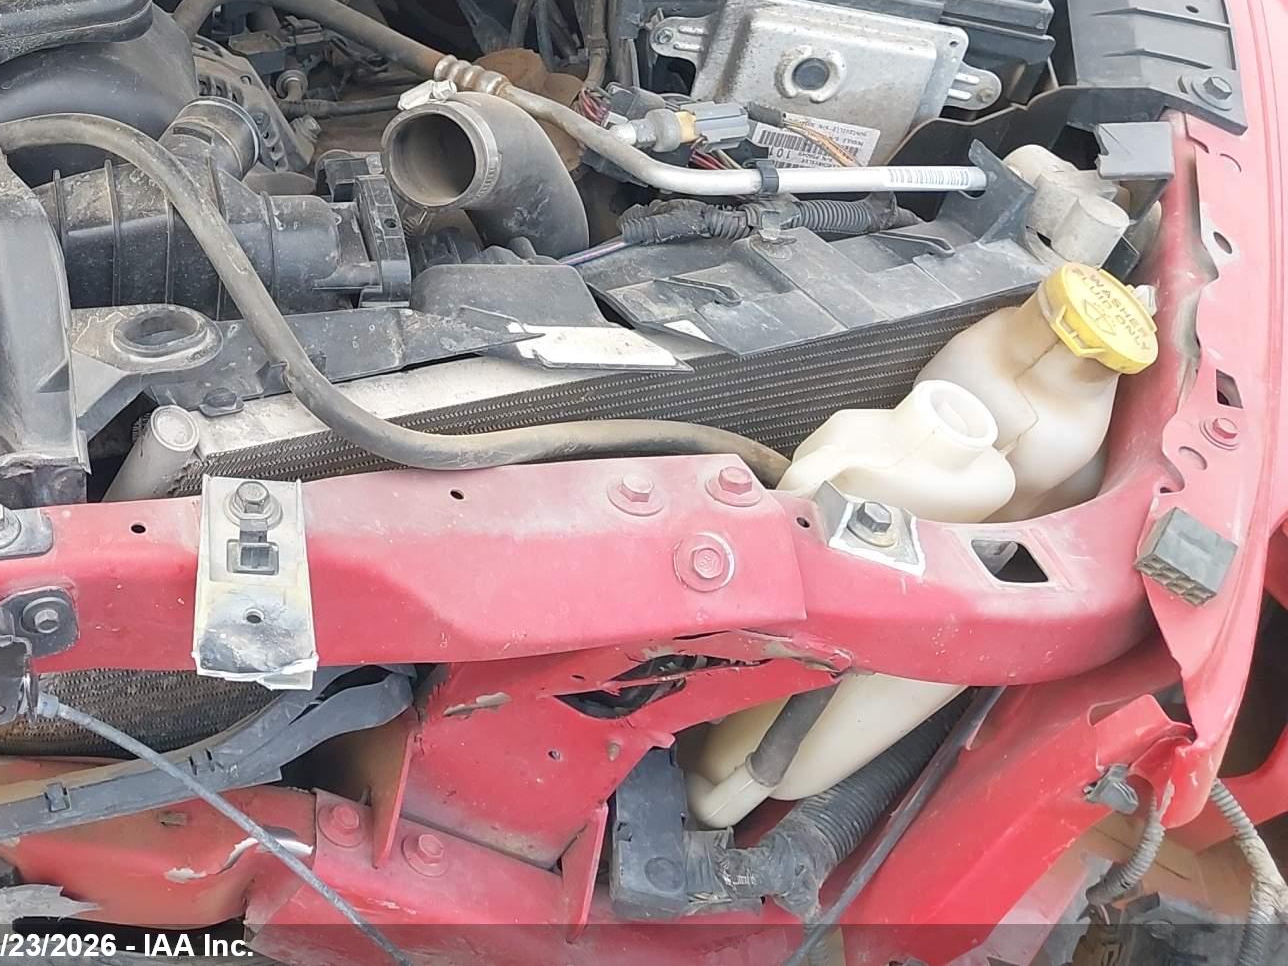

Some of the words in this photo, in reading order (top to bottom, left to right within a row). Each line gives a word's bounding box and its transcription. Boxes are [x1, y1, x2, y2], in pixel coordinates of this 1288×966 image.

[1072, 267, 1113, 310] FLUID
[1115, 314, 1151, 351] ONLY
[1089, 273, 1150, 338] WASHER
